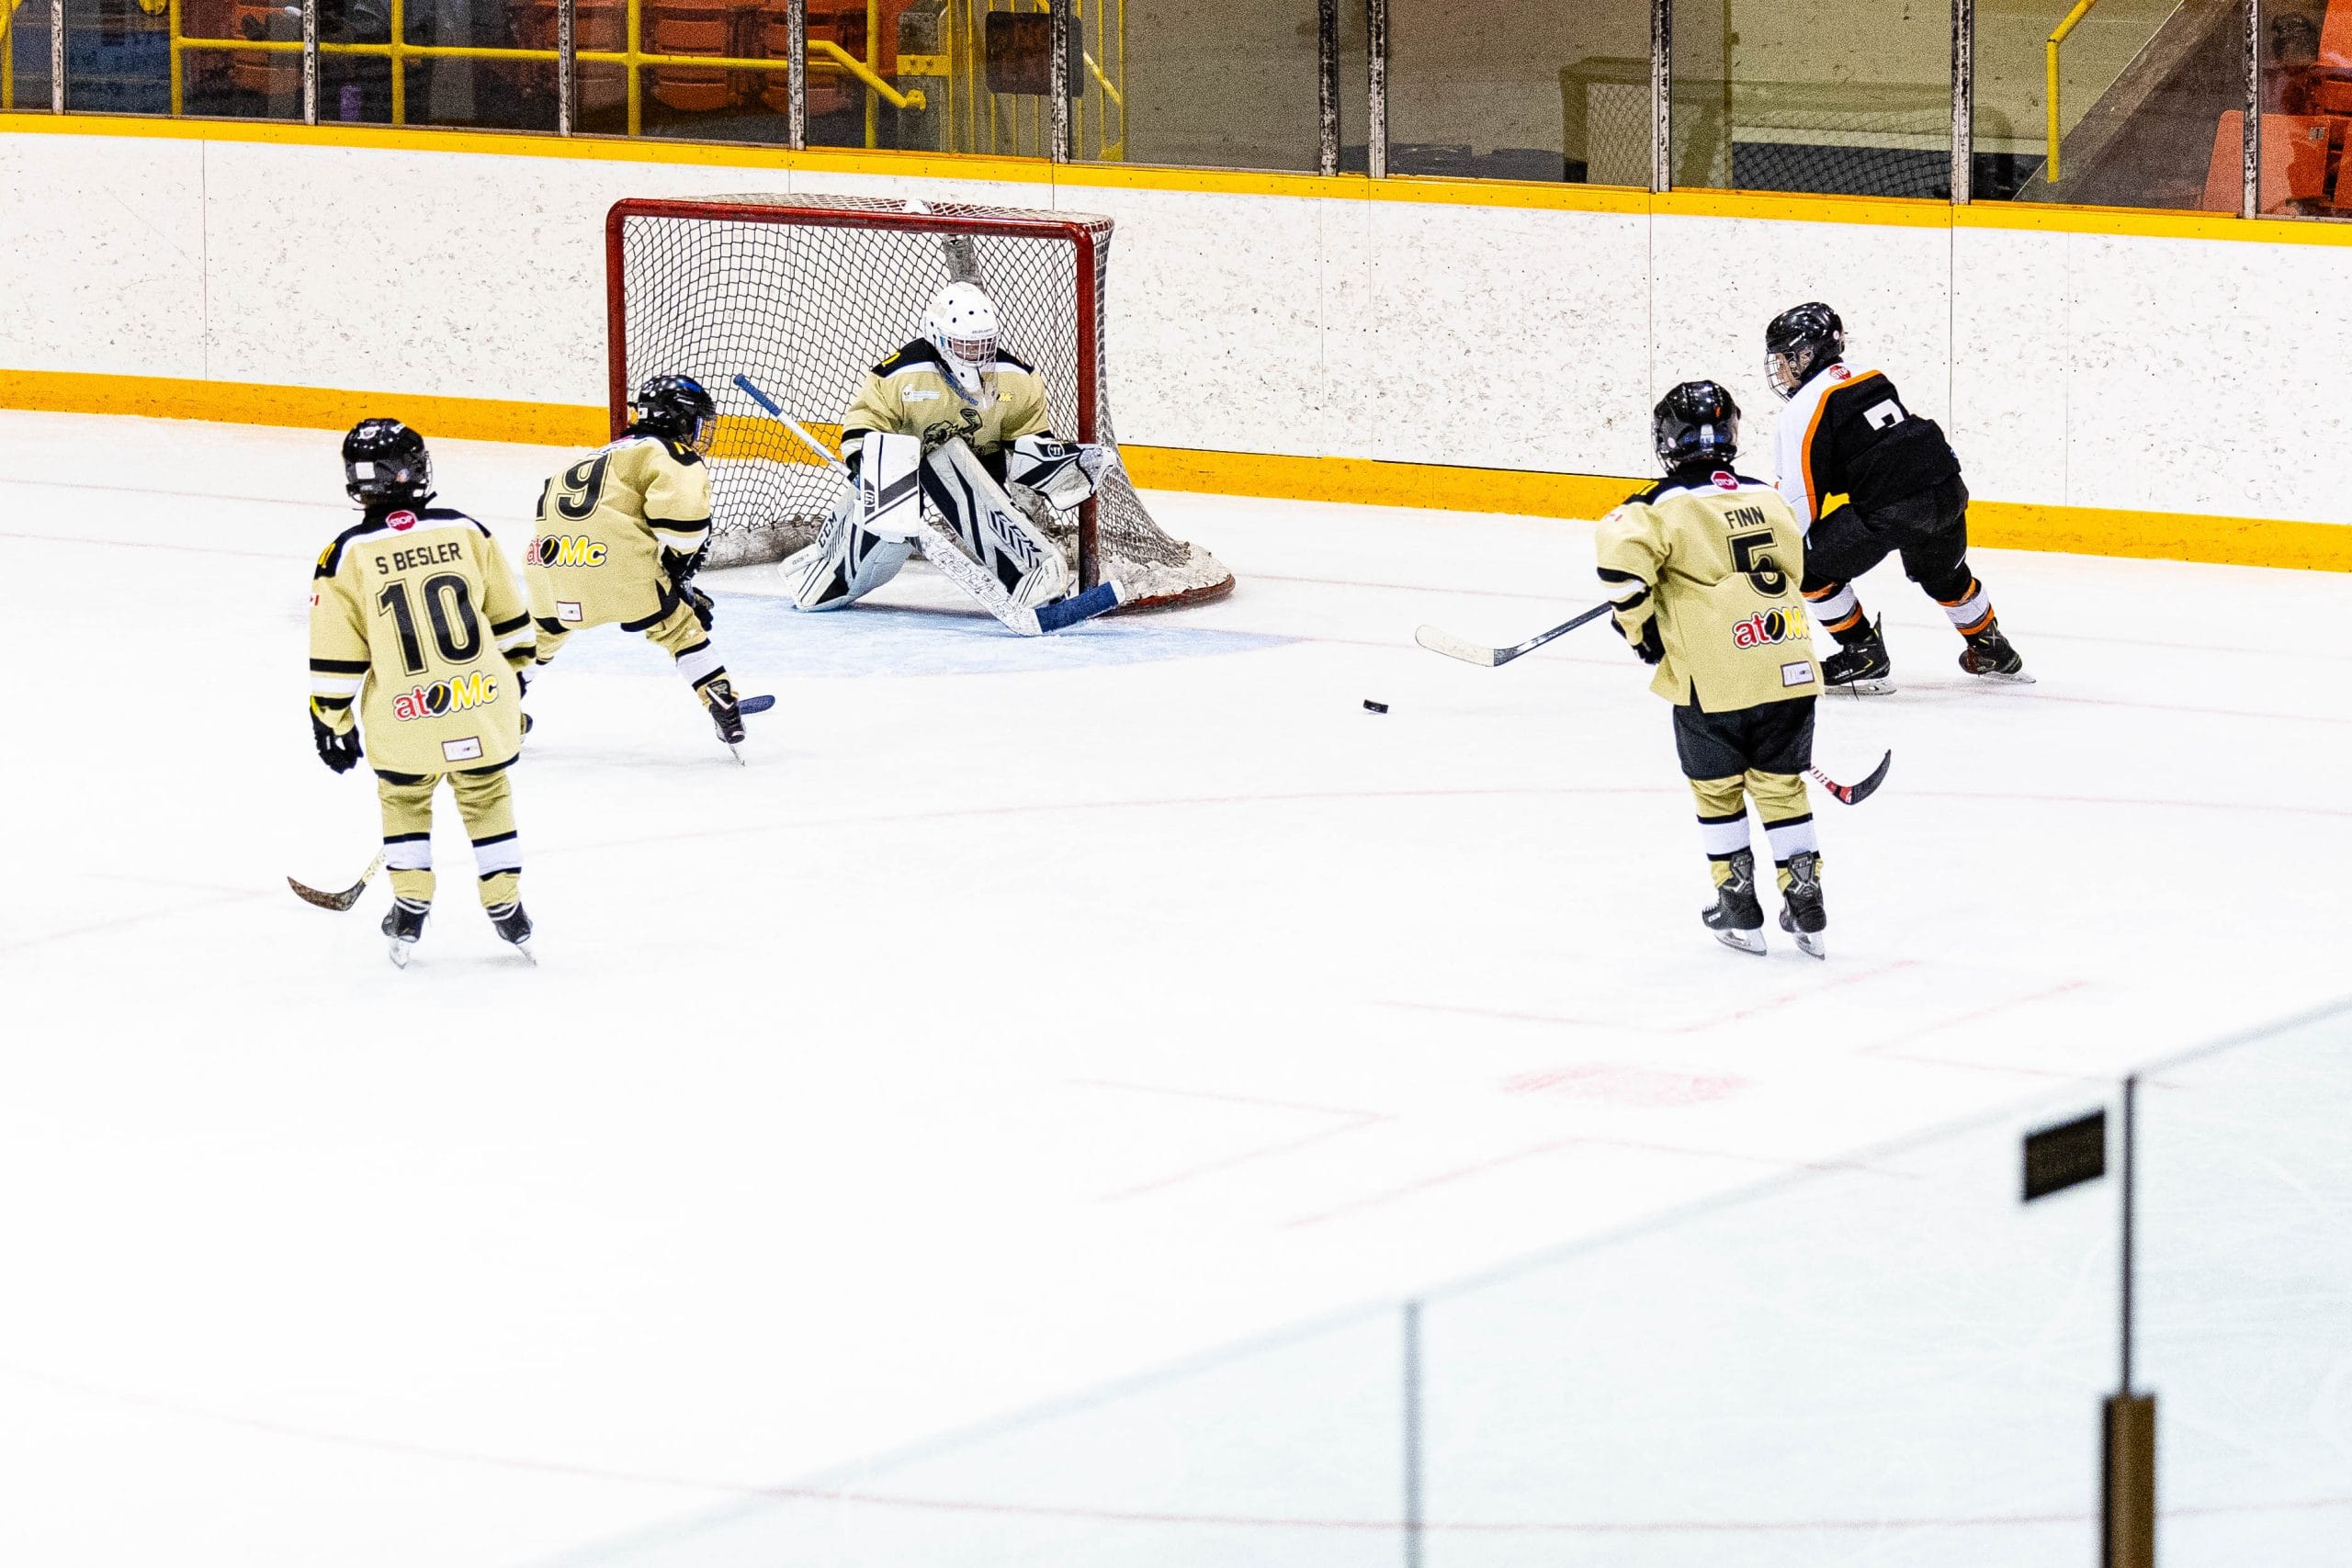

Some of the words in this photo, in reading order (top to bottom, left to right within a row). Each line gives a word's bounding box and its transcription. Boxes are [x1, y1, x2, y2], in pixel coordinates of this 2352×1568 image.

[389, 514, 413, 527] STOP
[818, 511, 838, 548] CCM
[1724, 506, 1766, 529] FINN
[376, 556, 389, 575] S
[392, 542, 463, 571] BESLER
[1726, 527, 1788, 599] 5
[376, 571, 483, 676] 10
